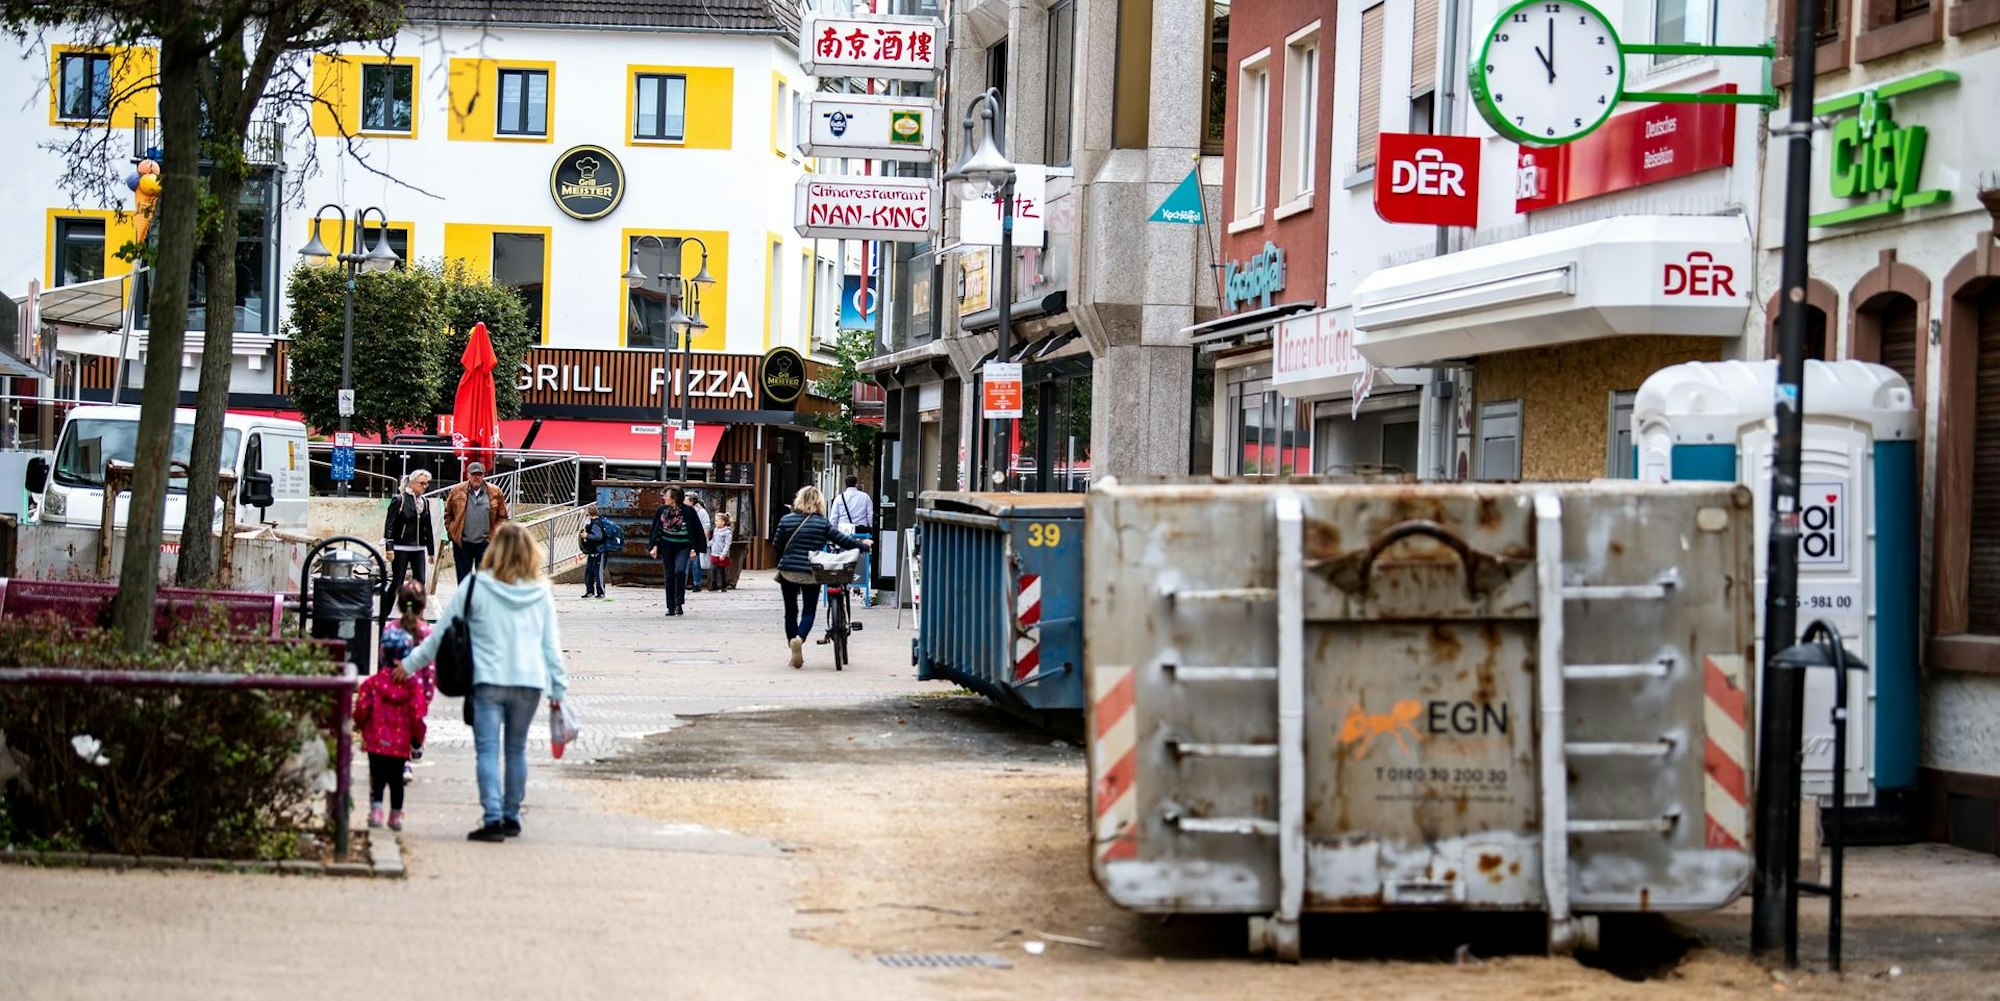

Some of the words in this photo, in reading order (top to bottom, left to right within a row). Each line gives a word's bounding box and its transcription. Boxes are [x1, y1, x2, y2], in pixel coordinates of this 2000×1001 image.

[1545, 4, 1561, 13] 12
[1513, 14, 1528, 23] 11
[1579, 16, 1586, 25] 1
[817, 26, 932, 63] 南京酒樓
[1493, 34, 1509, 43] 10
[1597, 36, 1605, 45] 2
[1486, 65, 1494, 74] 9
[1605, 66, 1613, 76] 3
[1495, 93, 1503, 102] 8
[1597, 95, 1606, 105] 4
[1516, 116, 1524, 126] 7
[1574, 118, 1582, 128] 5
[1547, 127, 1554, 136] 6
[1831, 92, 1927, 205] City
[1392, 158, 1466, 197] DER
[561, 184, 613, 197] MEISTER
[811, 184, 927, 201] Chinarestaurant
[810, 203, 927, 228] NAN-KING
[1663, 263, 1736, 297] DER
[1278, 313, 1361, 373] Linnenbrügge
[515, 364, 613, 393] GRILL
[650, 367, 753, 399] PIZZA
[1799, 503, 1836, 531] oi
[1028, 523, 1060, 547] 39
[1799, 532, 1835, 558] oi
[1811, 596, 1833, 608] 981
[1836, 596, 1852, 608] 00
[1428, 701, 1507, 734] EGN
